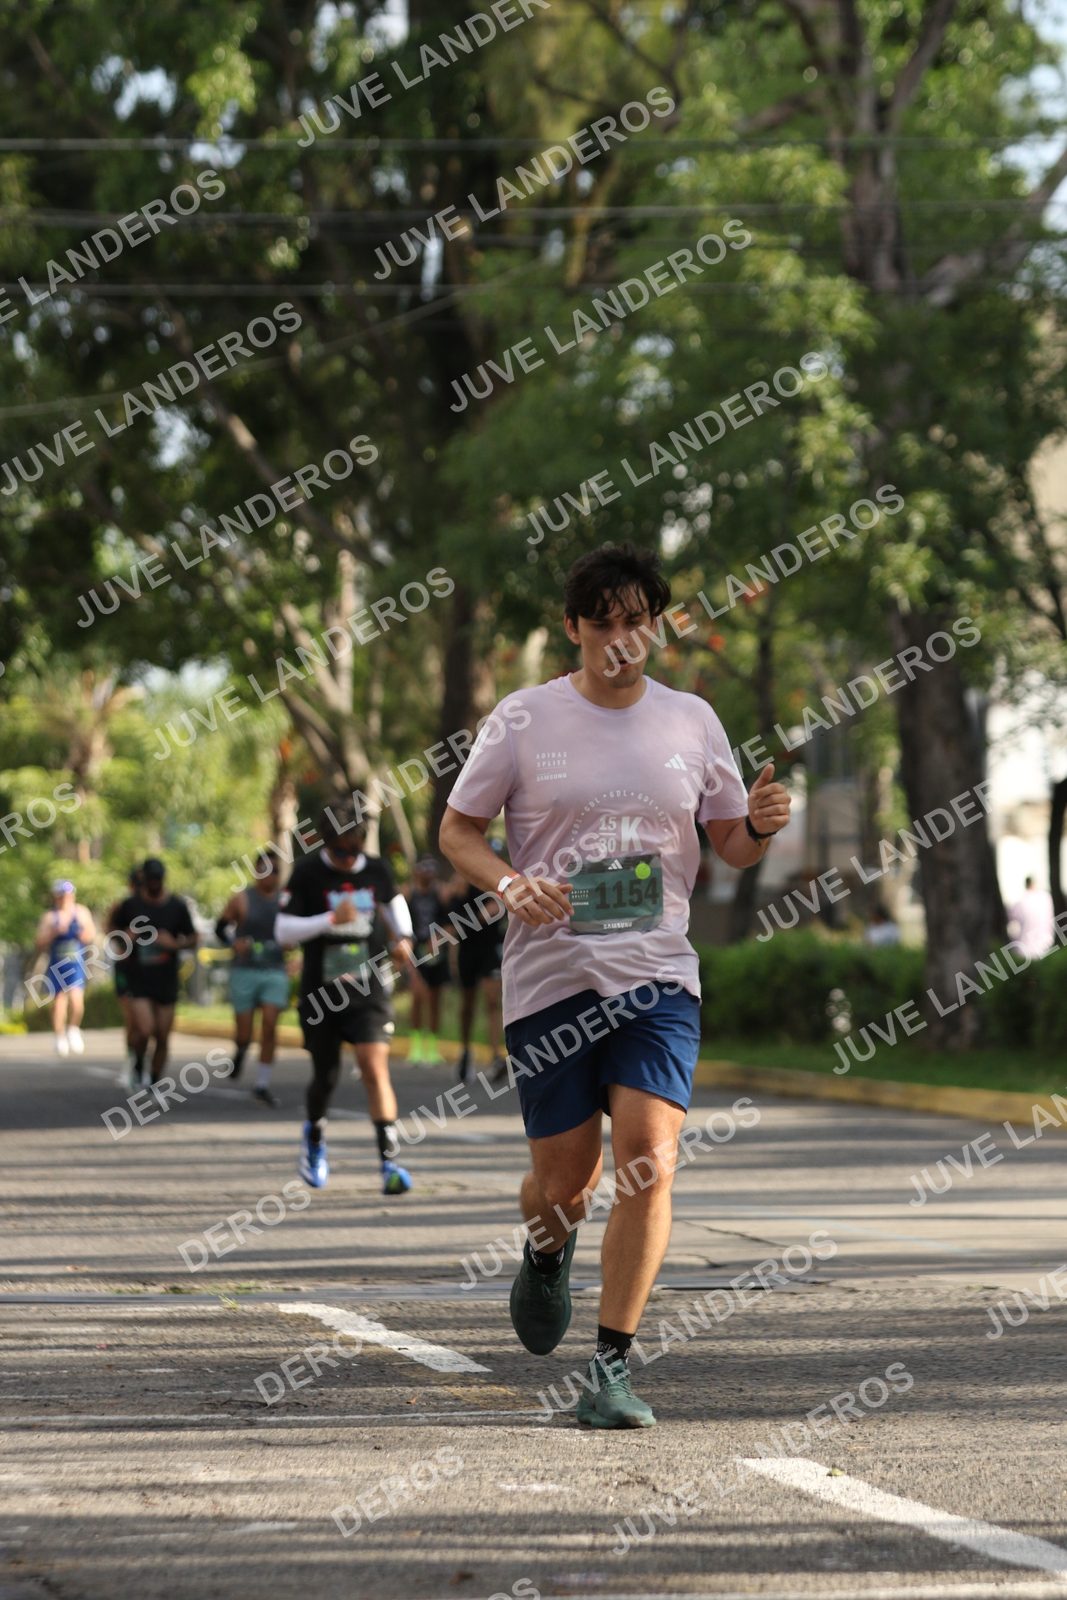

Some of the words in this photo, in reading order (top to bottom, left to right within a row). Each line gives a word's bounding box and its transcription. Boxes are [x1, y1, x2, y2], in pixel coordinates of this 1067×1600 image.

[599, 816, 617, 831] 15
[621, 816, 643, 852] K
[595, 877, 660, 909] 1154
